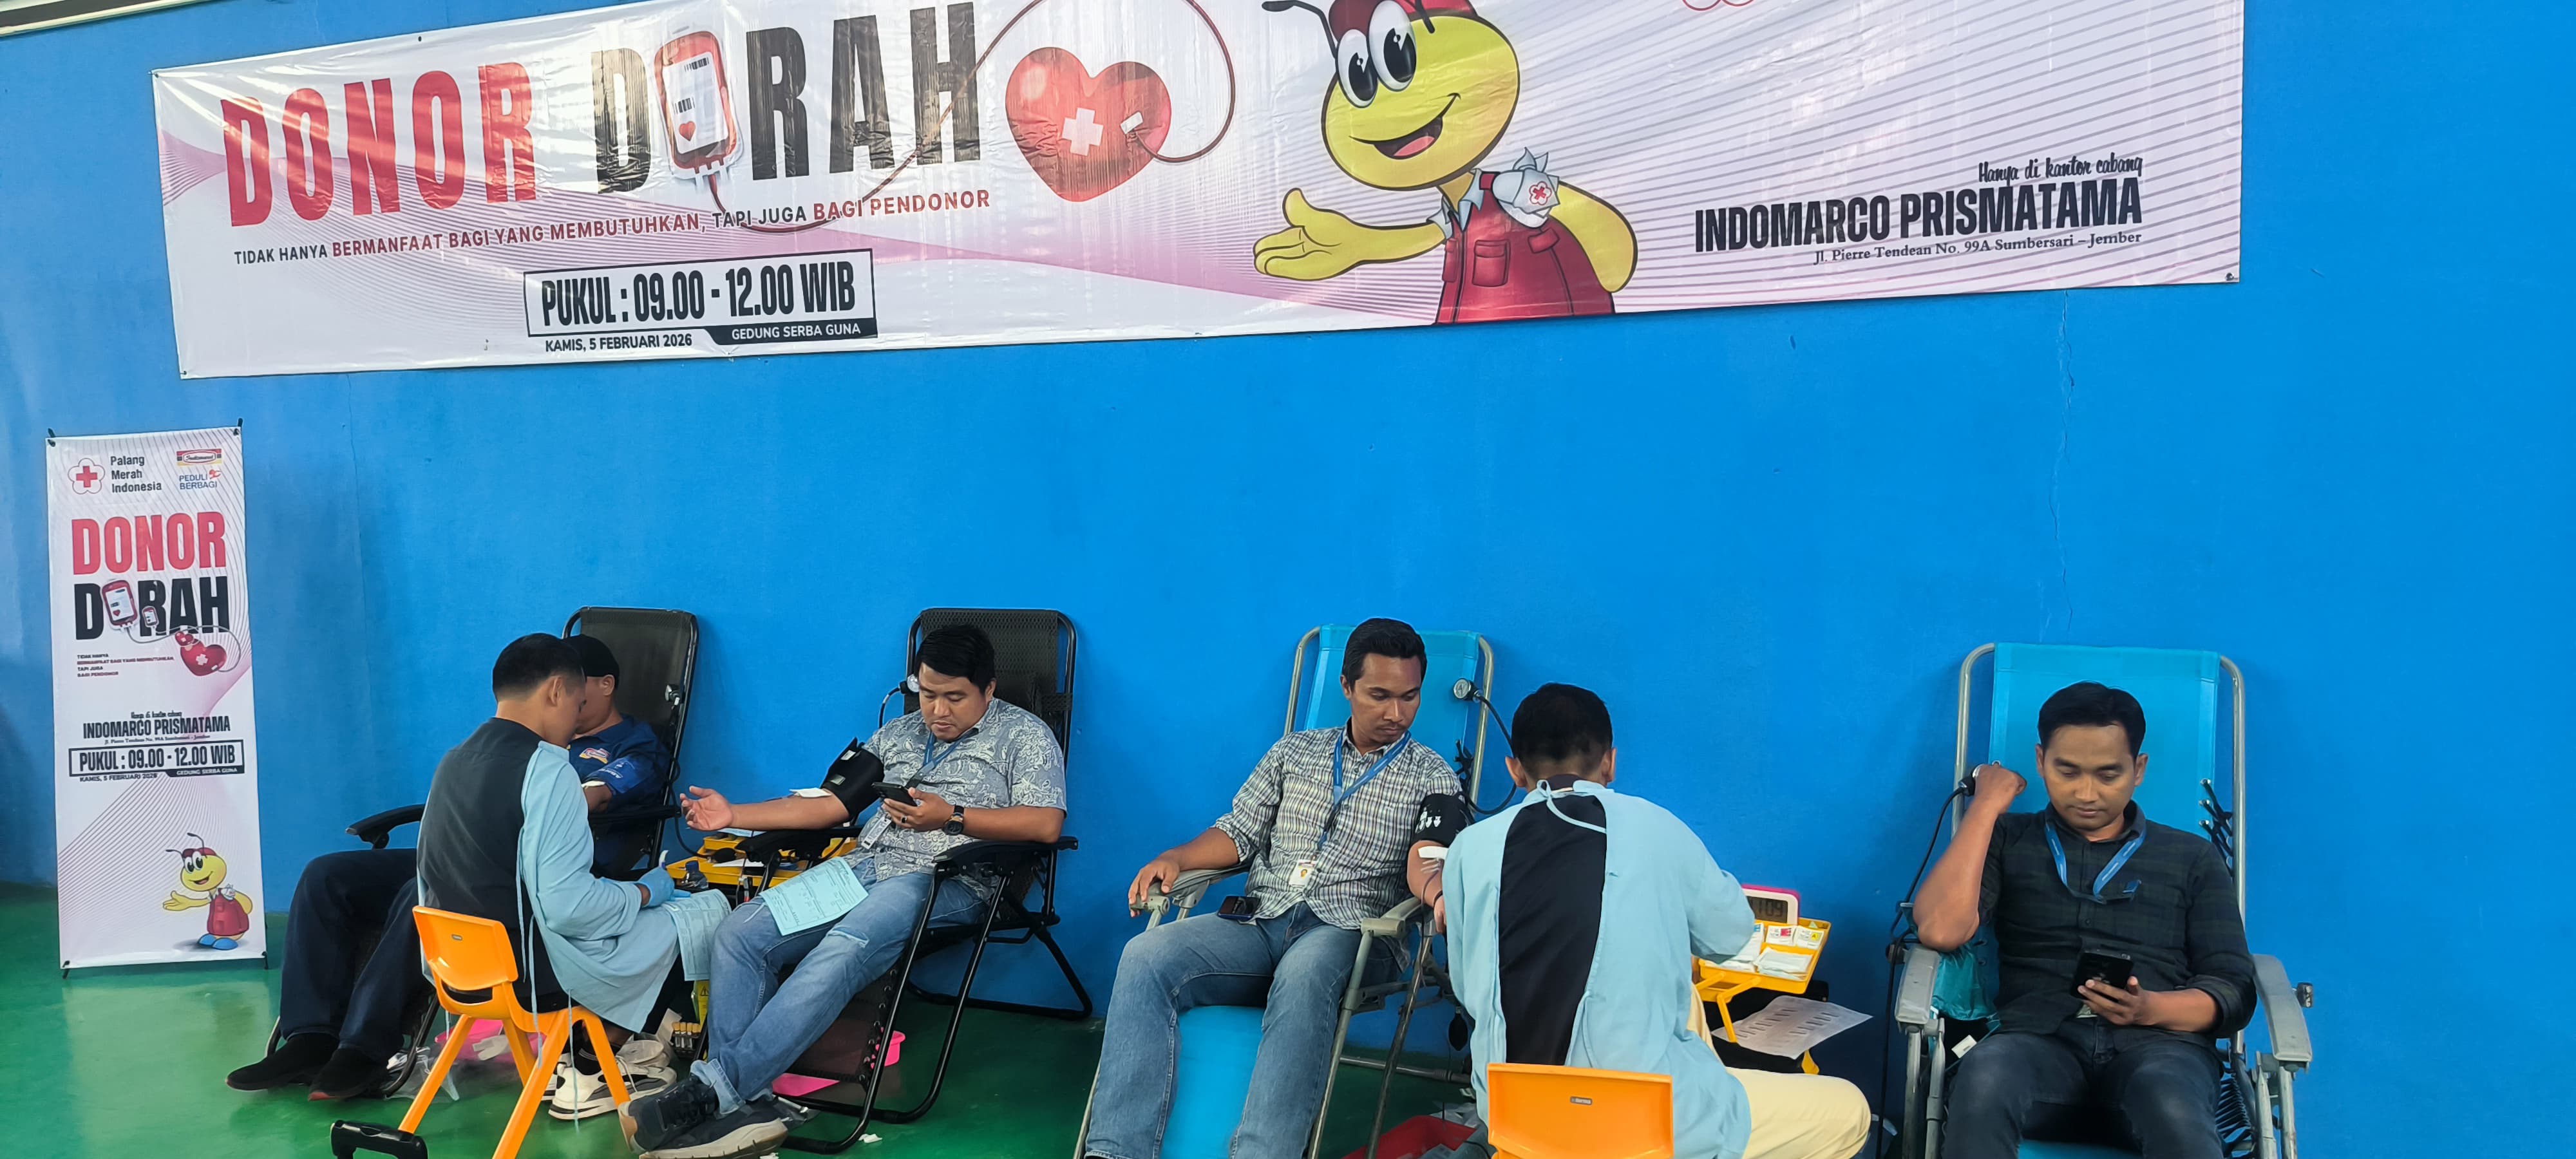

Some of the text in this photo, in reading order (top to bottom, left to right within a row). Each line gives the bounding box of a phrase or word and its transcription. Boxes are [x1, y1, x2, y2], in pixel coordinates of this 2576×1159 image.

[221, 1, 981, 227] DONOR DRAH
[1978, 152, 2143, 186] Hanya di kantor cabang
[234, 189, 990, 265] TIDAK HANYA BERMANFAAT BAGI YANG MEMBUTUHKAN, TAPI JUGA BAGI PENDONOR
[1695, 177, 2142, 253] INDOMARCO PRISMATAMA
[1813, 250, 1828, 265] Jl.
[1832, 249, 1871, 261] Pierre
[1874, 245, 1931, 258] Tendean
[1935, 243, 1960, 255] No.
[1964, 240, 1991, 252] 99A
[1994, 234, 2074, 250] Sumbersari
[2087, 232, 2142, 249] Jember
[542, 275, 616, 326] PUKUL
[633, 270, 705, 321] 09.00
[725, 265, 793, 317] 12.00
[800, 261, 855, 313] WIB
[545, 334, 692, 352] KAMIS, 5 FEBRUARI 2026
[732, 323, 860, 340] GEDUNG SERBA GUNA
[110, 455, 146, 467] Palang
[111, 469, 142, 480] Merah
[111, 481, 162, 493] Indonesia
[179, 474, 208, 482] PEDULI
[180, 481, 218, 490] BERBAGI
[71, 511, 227, 575] DONOR
[73, 576, 230, 640] DRAH
[83, 715, 231, 739] INDOMARCO PRISMATAMA
[79, 751, 119, 771] PUKUL
[128, 748, 164, 769] 09.00
[175, 746, 207, 766] 12.00
[211, 745, 236, 764] WIB
